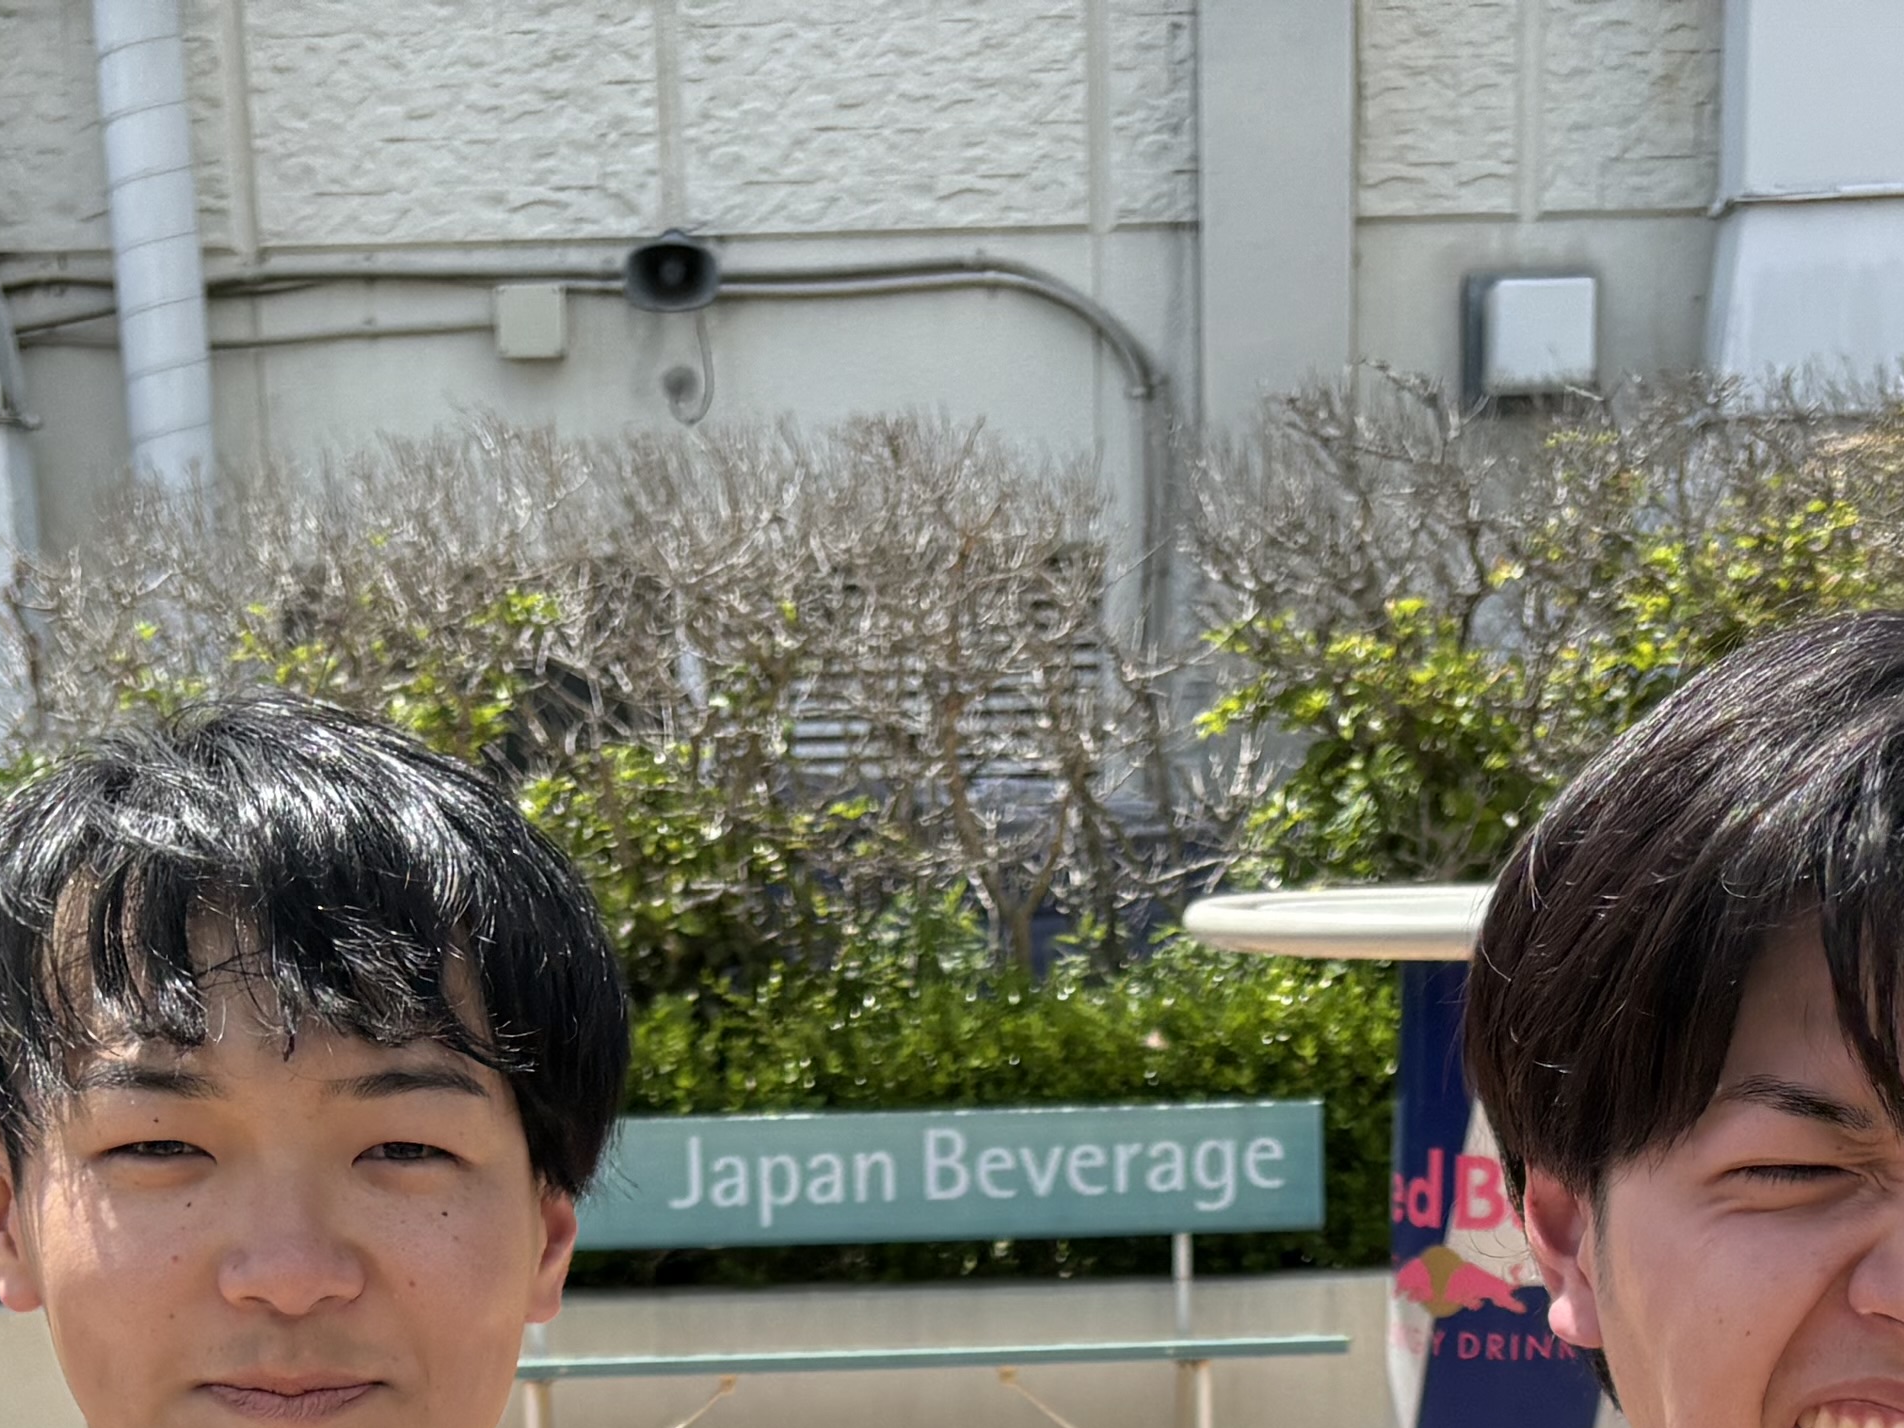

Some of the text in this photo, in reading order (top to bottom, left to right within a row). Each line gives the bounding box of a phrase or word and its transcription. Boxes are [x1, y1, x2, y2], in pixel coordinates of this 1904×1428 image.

[668, 1128, 1286, 1229] Japan Beverage
[1392, 1148, 1443, 1230] ed
